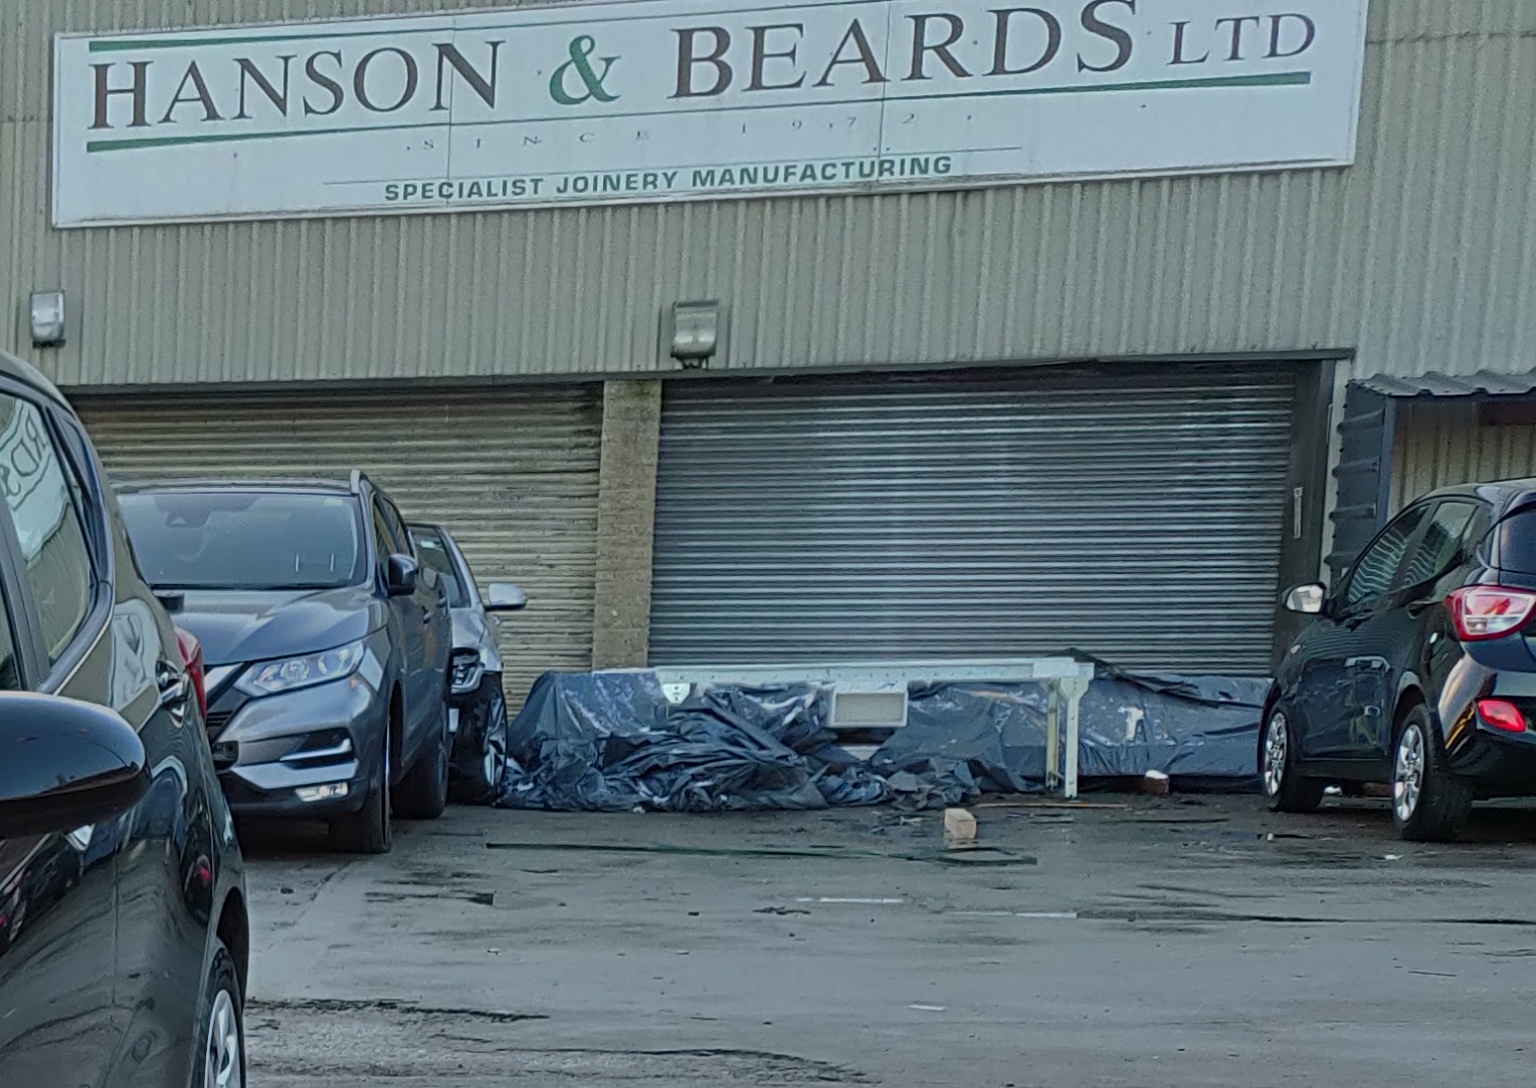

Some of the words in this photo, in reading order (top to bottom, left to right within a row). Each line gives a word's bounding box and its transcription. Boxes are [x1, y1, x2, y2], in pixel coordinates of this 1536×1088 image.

[87, 40, 506, 130] HANSON
[549, 35, 622, 105] &
[667, 0, 1137, 100] BEARDS
[1166, 13, 1316, 65] LTD
[384, 177, 544, 201] SPECIALIST
[556, 171, 679, 195] JOINERY
[691, 155, 953, 189] MANUFACTURING
